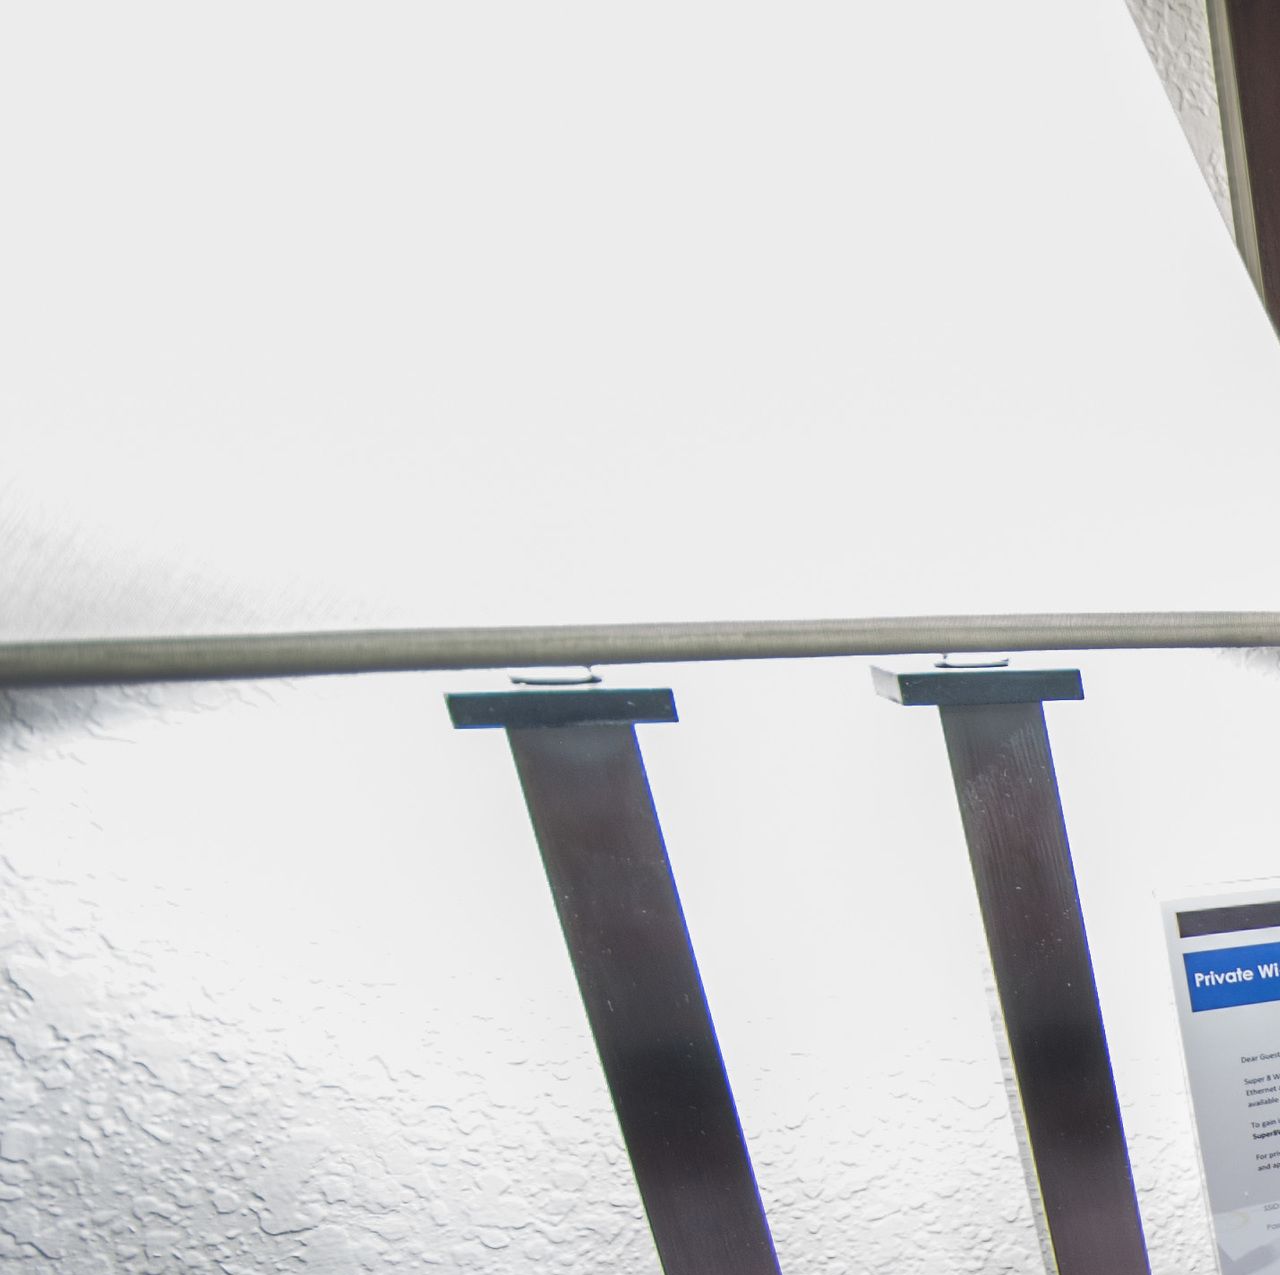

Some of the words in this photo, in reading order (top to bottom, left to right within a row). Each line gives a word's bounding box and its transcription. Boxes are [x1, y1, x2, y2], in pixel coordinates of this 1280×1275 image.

[1195, 967, 1253, 987] Private
[1241, 1055, 1258, 1063] Dear
[1244, 1077, 1265, 1085] Super
[1246, 1086, 1277, 1097] Ethernet
[1248, 1096, 1279, 1108] available
[1262, 1118, 1276, 1127] gain
[1256, 1153, 1267, 1161] For
